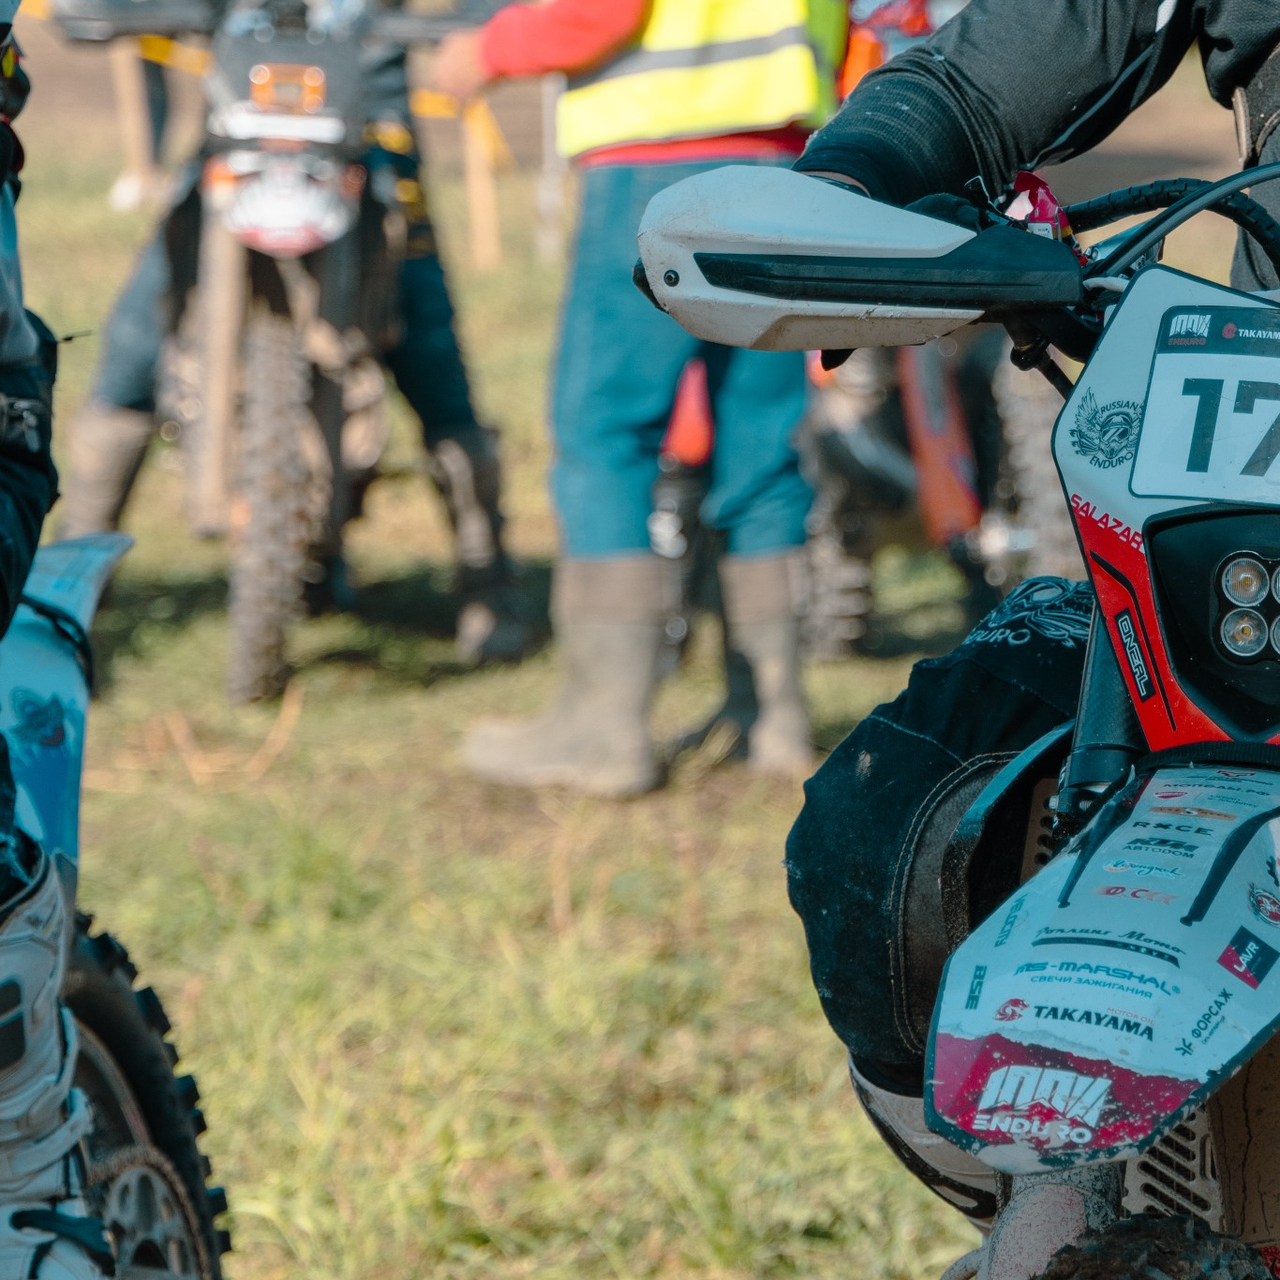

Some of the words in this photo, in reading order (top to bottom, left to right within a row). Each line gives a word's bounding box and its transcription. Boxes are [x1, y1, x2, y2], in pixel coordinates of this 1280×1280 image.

[1100, 400, 1139, 415] RUSSIAN
[1089, 451, 1134, 470] ENDURO
[1122, 844, 1195, 859] АВТОДОМ
[1126, 837, 1200, 852] KTM
[1233, 942, 1260, 972] LAVR
[1030, 975, 1073, 984] СВЕЧИ
[1074, 977, 1153, 1000] ЗАЖИГАНИЯ
[1033, 1004, 1154, 1042] TAKAYAMA
[1105, 1006, 1139, 1020] MOTOR
[1139, 1015, 1155, 1025] OIL
[1191, 987, 1233, 1040] ФОРСАЖ
